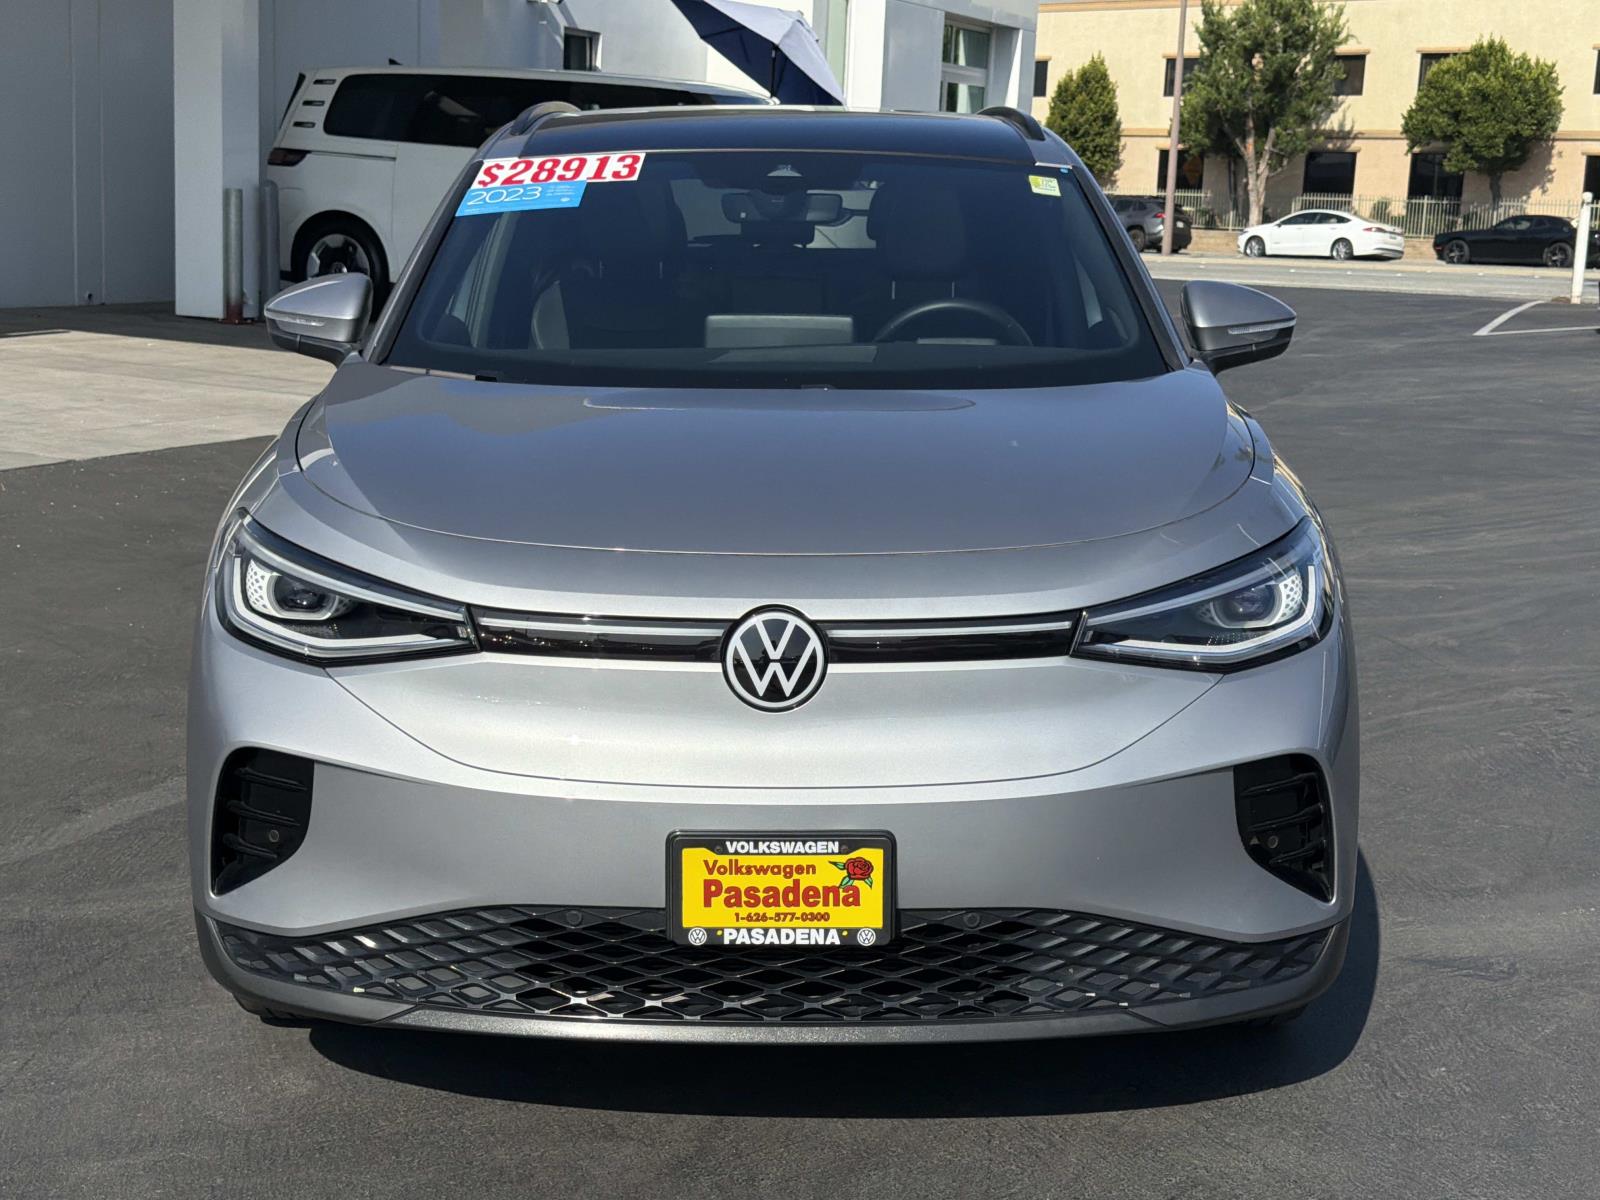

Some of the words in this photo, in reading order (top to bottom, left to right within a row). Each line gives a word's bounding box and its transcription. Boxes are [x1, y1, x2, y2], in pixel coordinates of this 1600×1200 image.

[478, 154, 641, 187] $28913
[467, 186, 542, 206] 2023
[726, 841, 839, 854] VOLKSWAGEN
[703, 859, 816, 879] Volkswagen
[703, 878, 861, 908] Pasadena
[734, 912, 830, 922] 1-626-577-0300
[723, 928, 841, 945] PASADENA
